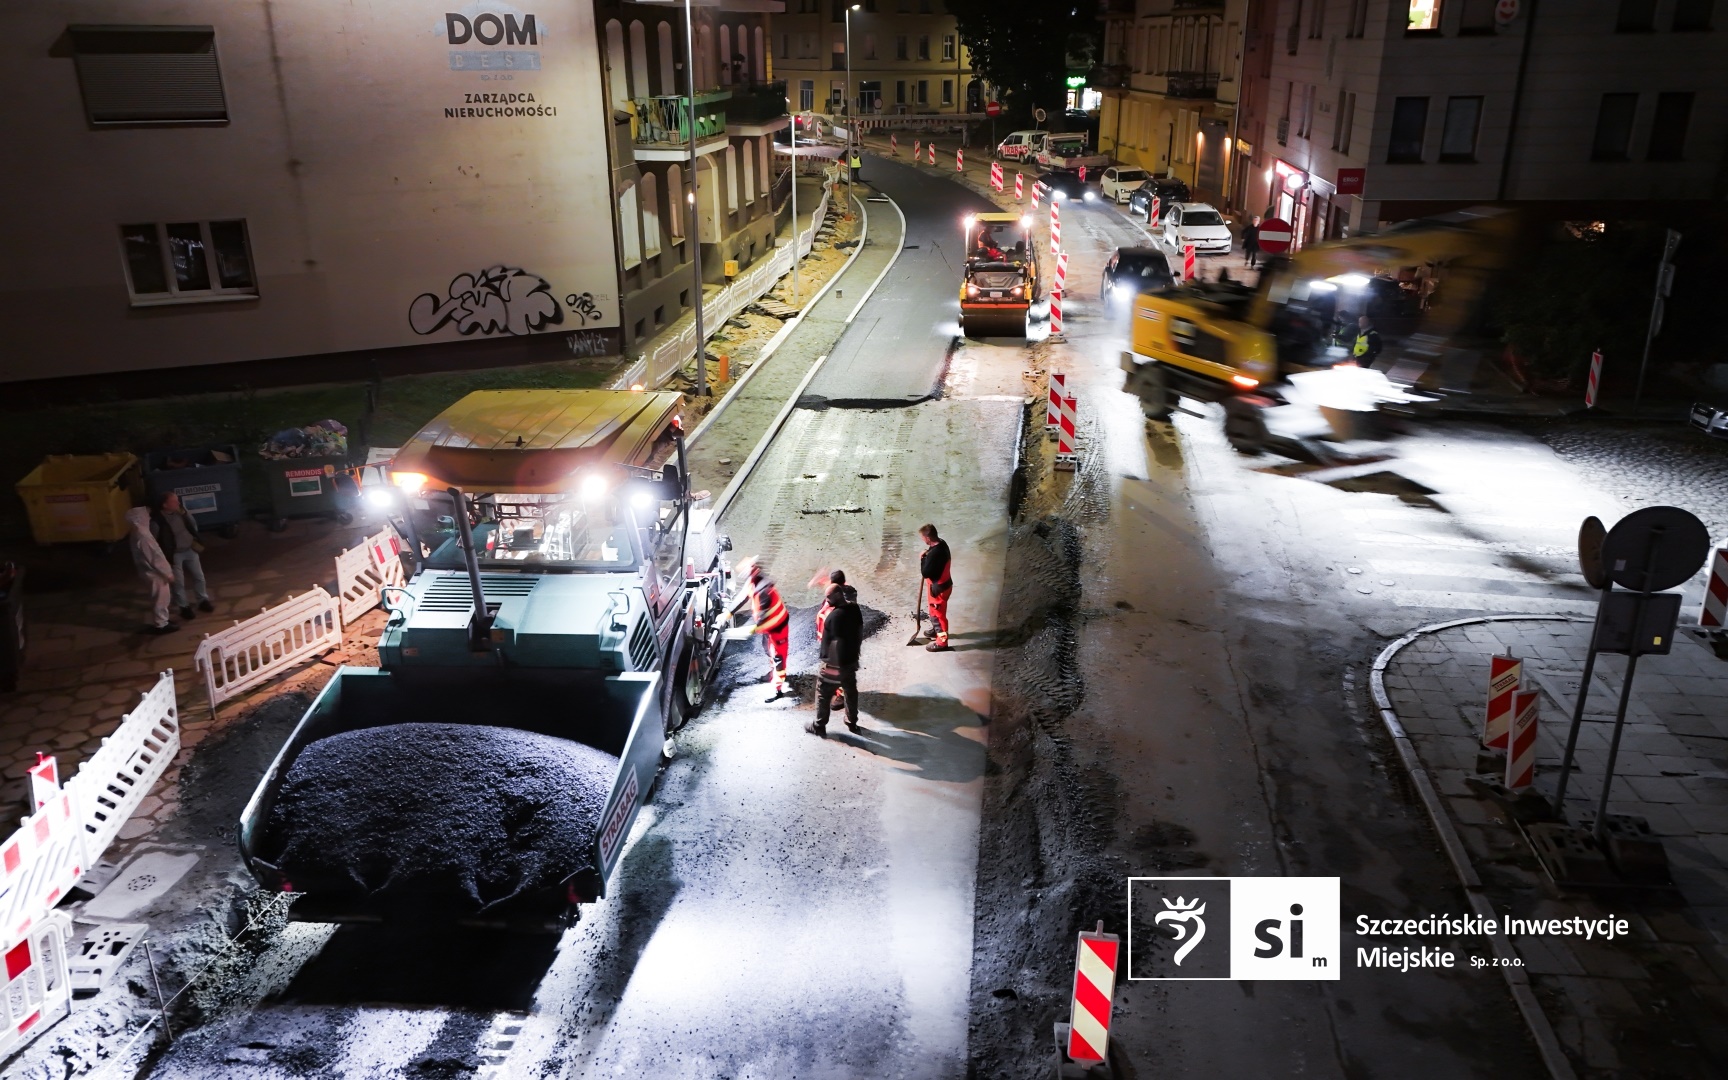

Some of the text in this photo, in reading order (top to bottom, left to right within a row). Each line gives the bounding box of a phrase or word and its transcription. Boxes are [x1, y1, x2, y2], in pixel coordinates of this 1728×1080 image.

[445, 13, 538, 45] DOM
[455, 54, 537, 67] BEST
[464, 93, 535, 105] ZARZĄDCA
[444, 105, 557, 118] NIERUCHOMOŚCI
[285, 468, 322, 478] REMONDIS
[175, 484, 217, 495] REMONDIS
[602, 780, 636, 855] STRABAG
